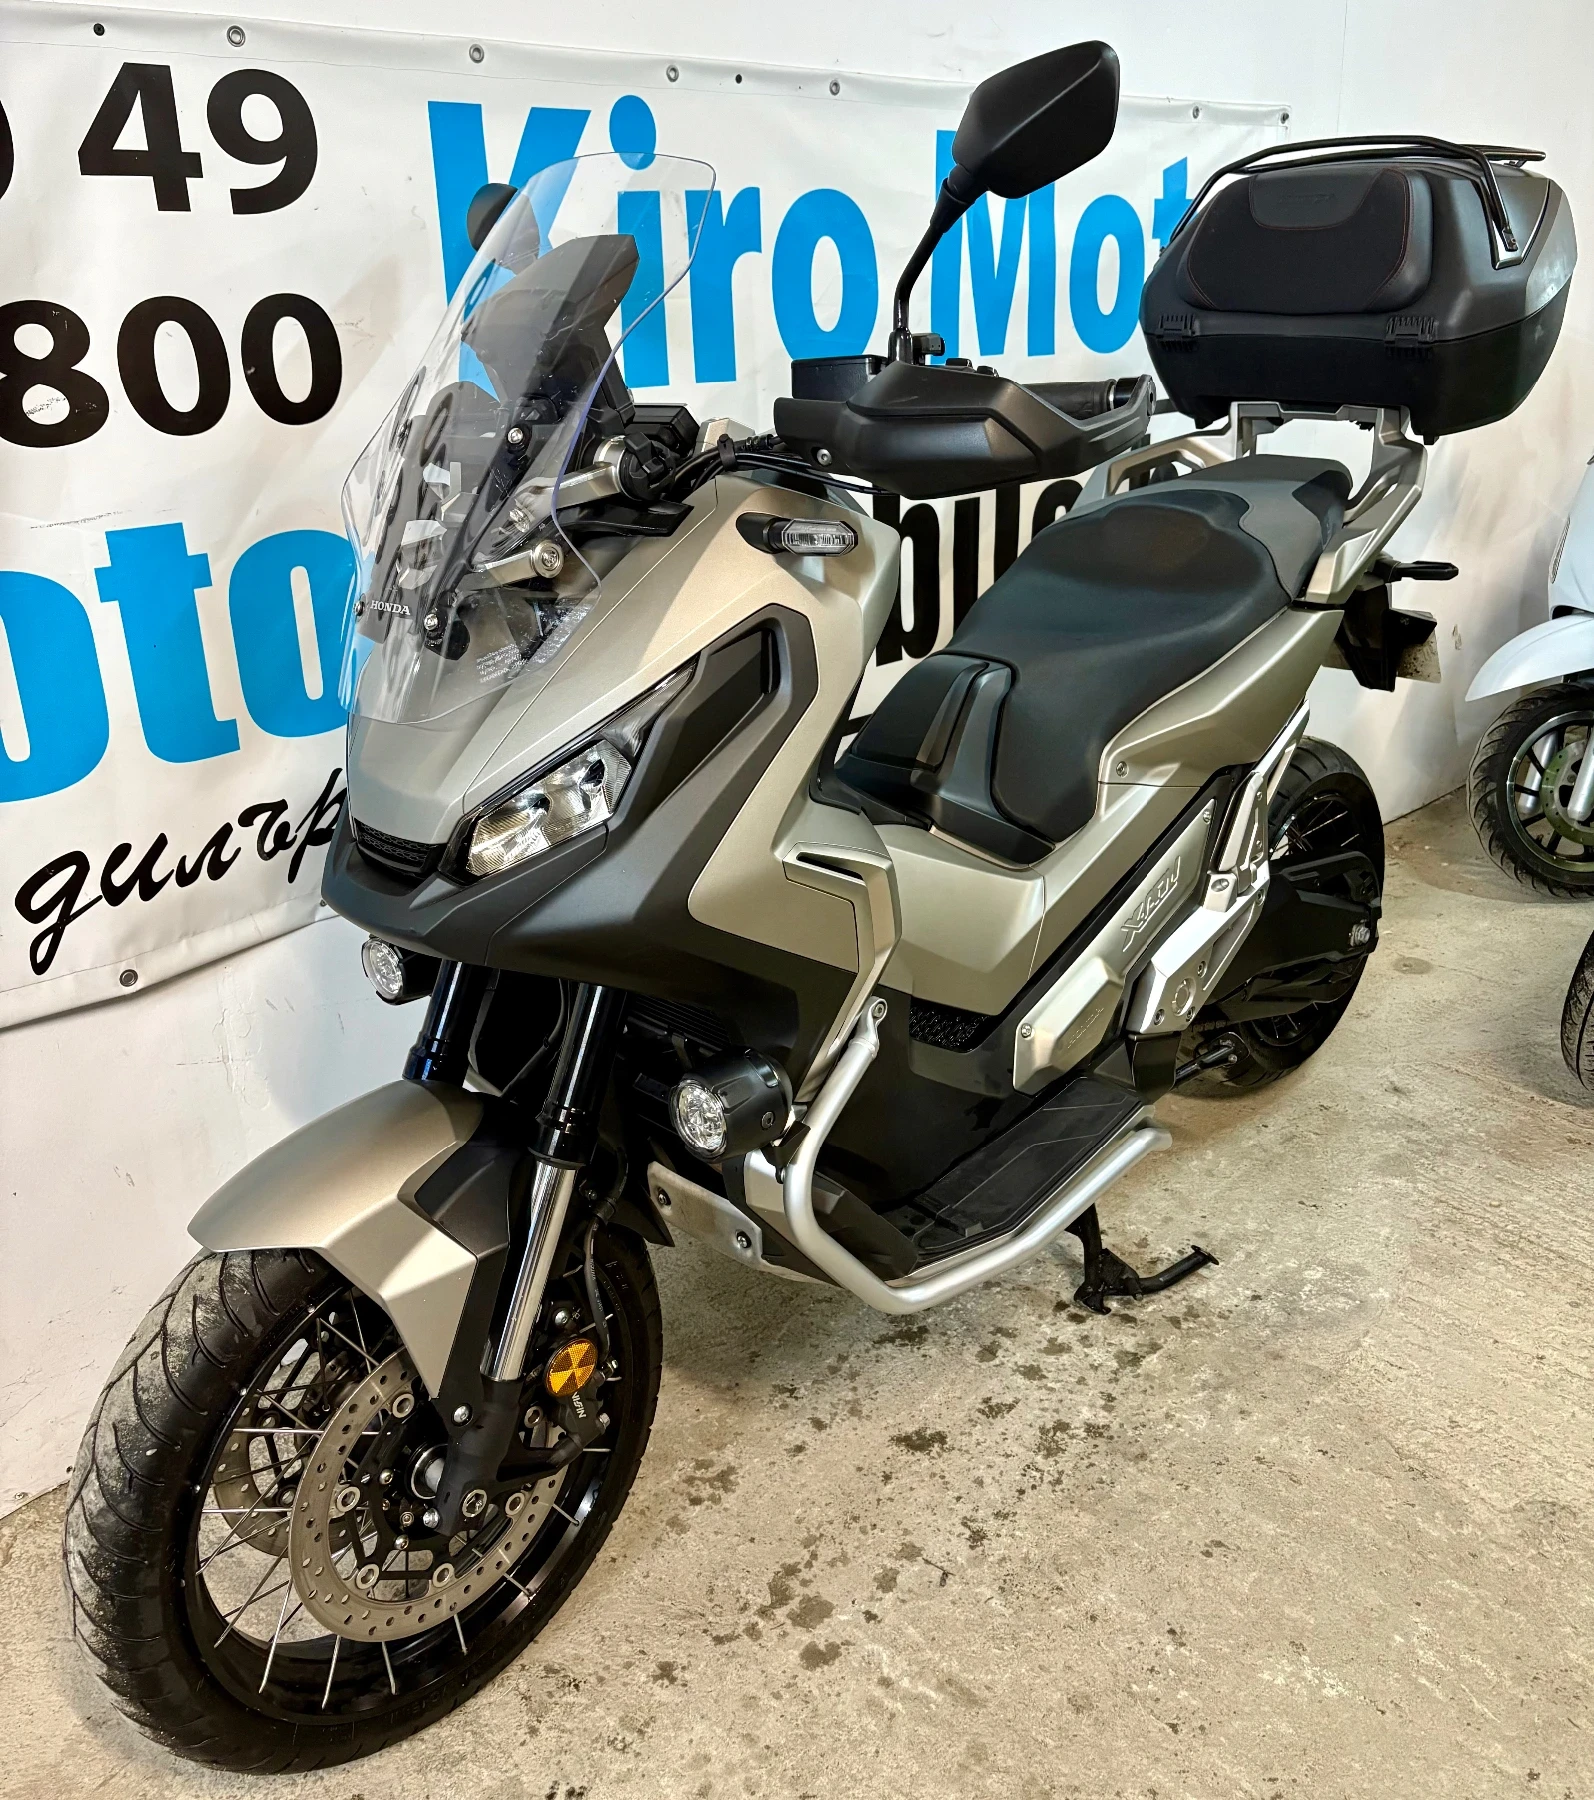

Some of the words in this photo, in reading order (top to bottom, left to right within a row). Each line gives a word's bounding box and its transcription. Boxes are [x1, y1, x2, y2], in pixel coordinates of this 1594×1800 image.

[78, 62, 318, 215] 49
[427, 94, 878, 403] Kiro
[370, 600, 411, 615] HONDA
